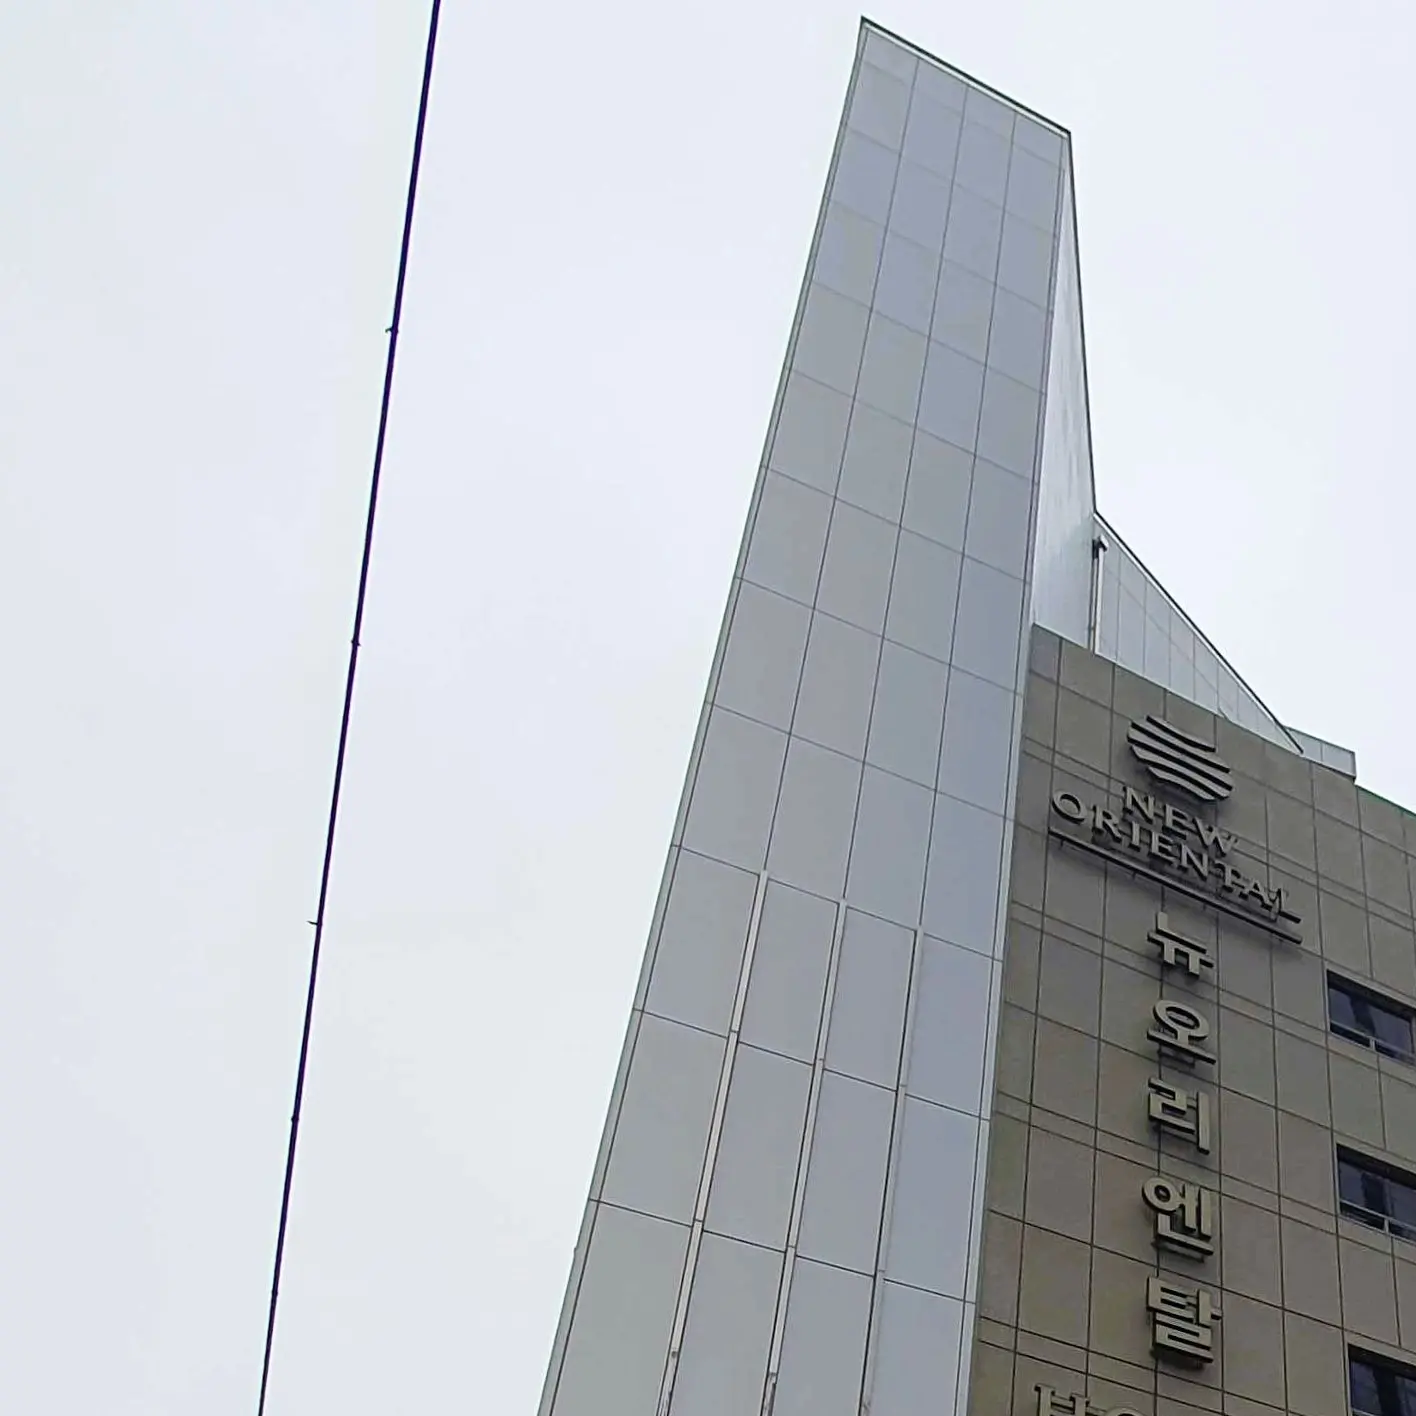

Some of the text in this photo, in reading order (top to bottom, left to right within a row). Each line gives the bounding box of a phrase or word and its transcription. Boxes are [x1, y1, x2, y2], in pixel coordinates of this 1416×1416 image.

[1051, 789, 1301, 923] ORIENTAL
[1122, 785, 1240, 857] NEW
[1141, 911, 1222, 1363] 뉴오리엔탈
